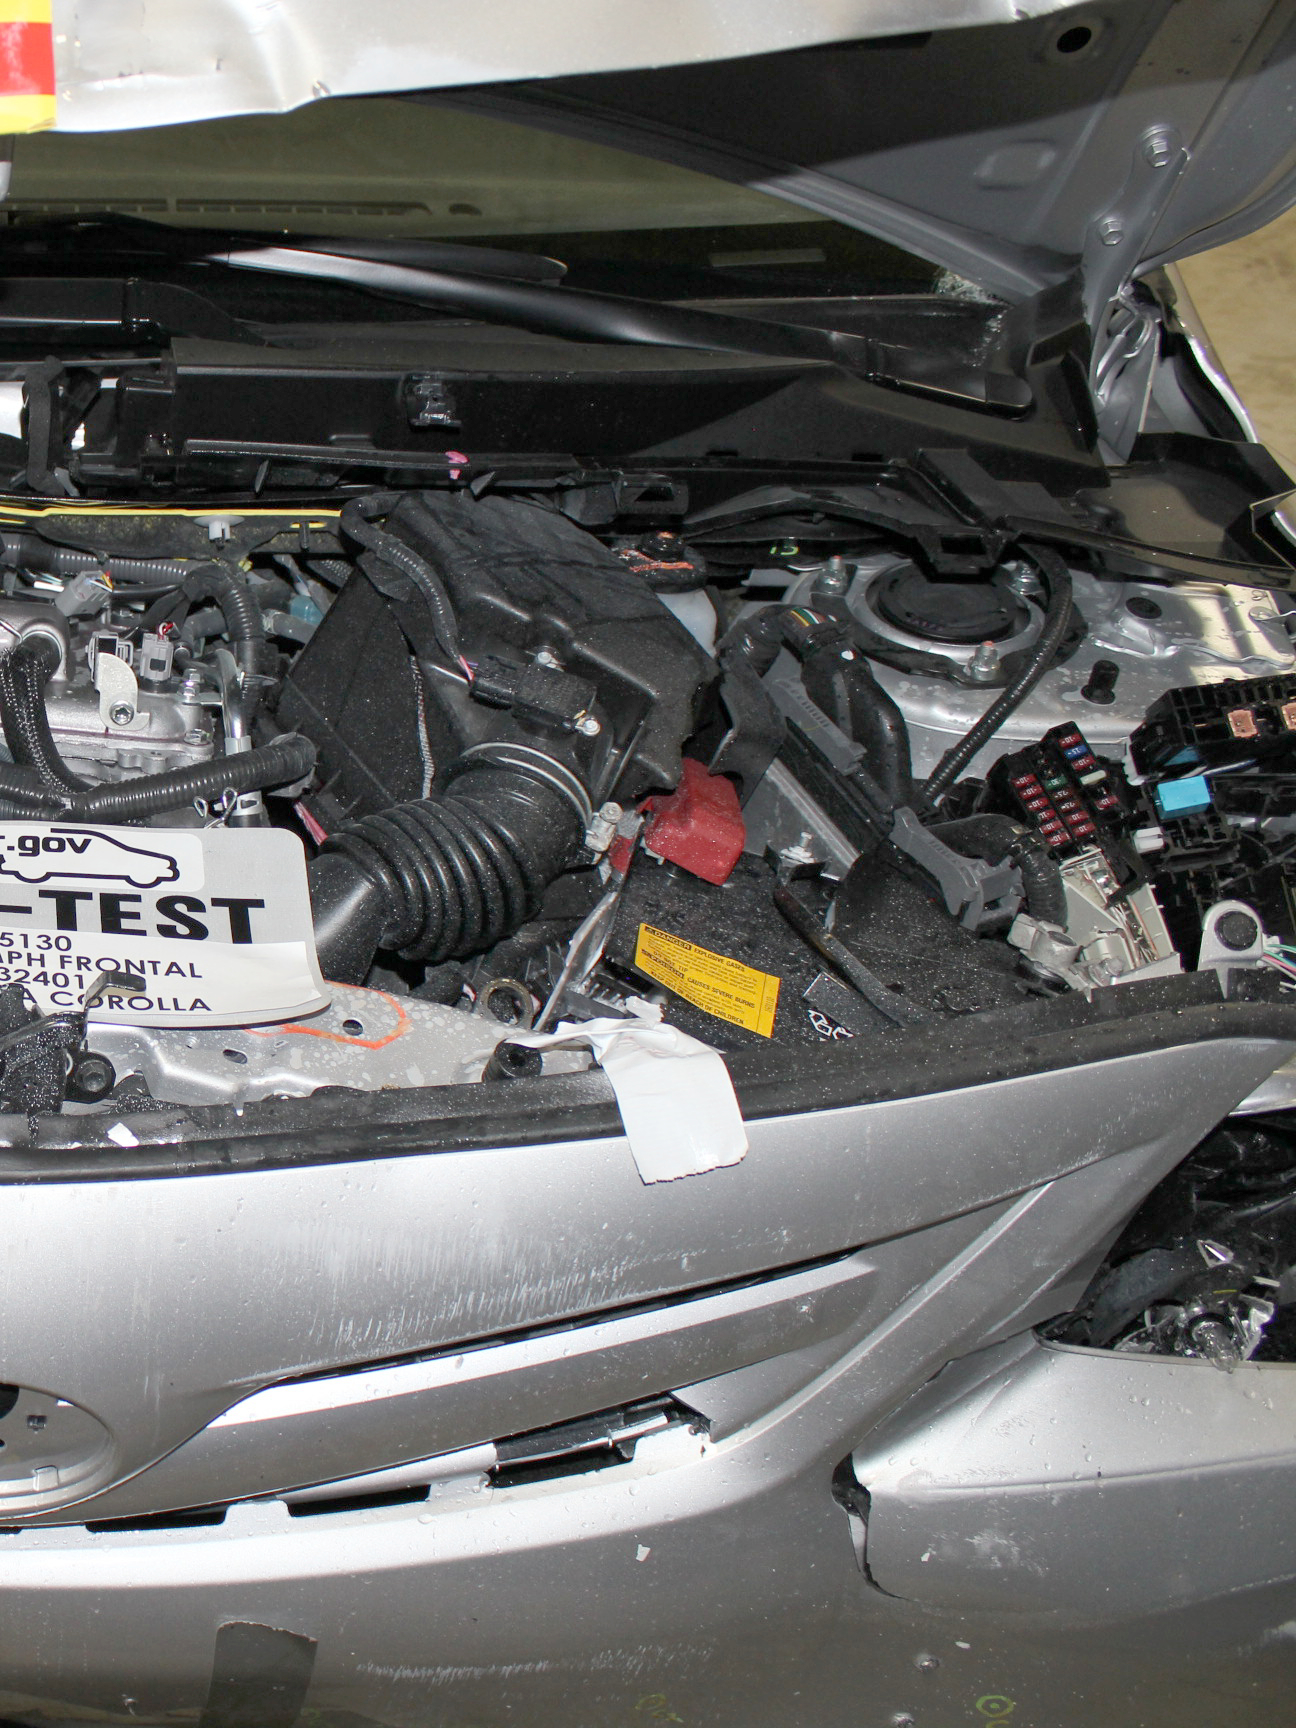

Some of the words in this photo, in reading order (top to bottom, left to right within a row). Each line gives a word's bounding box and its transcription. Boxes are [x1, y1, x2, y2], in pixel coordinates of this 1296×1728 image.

[654, 930, 692, 951] DANGER
[60, 954, 203, 979] FRONTAL
[50, 991, 213, 1012] COROLLA
